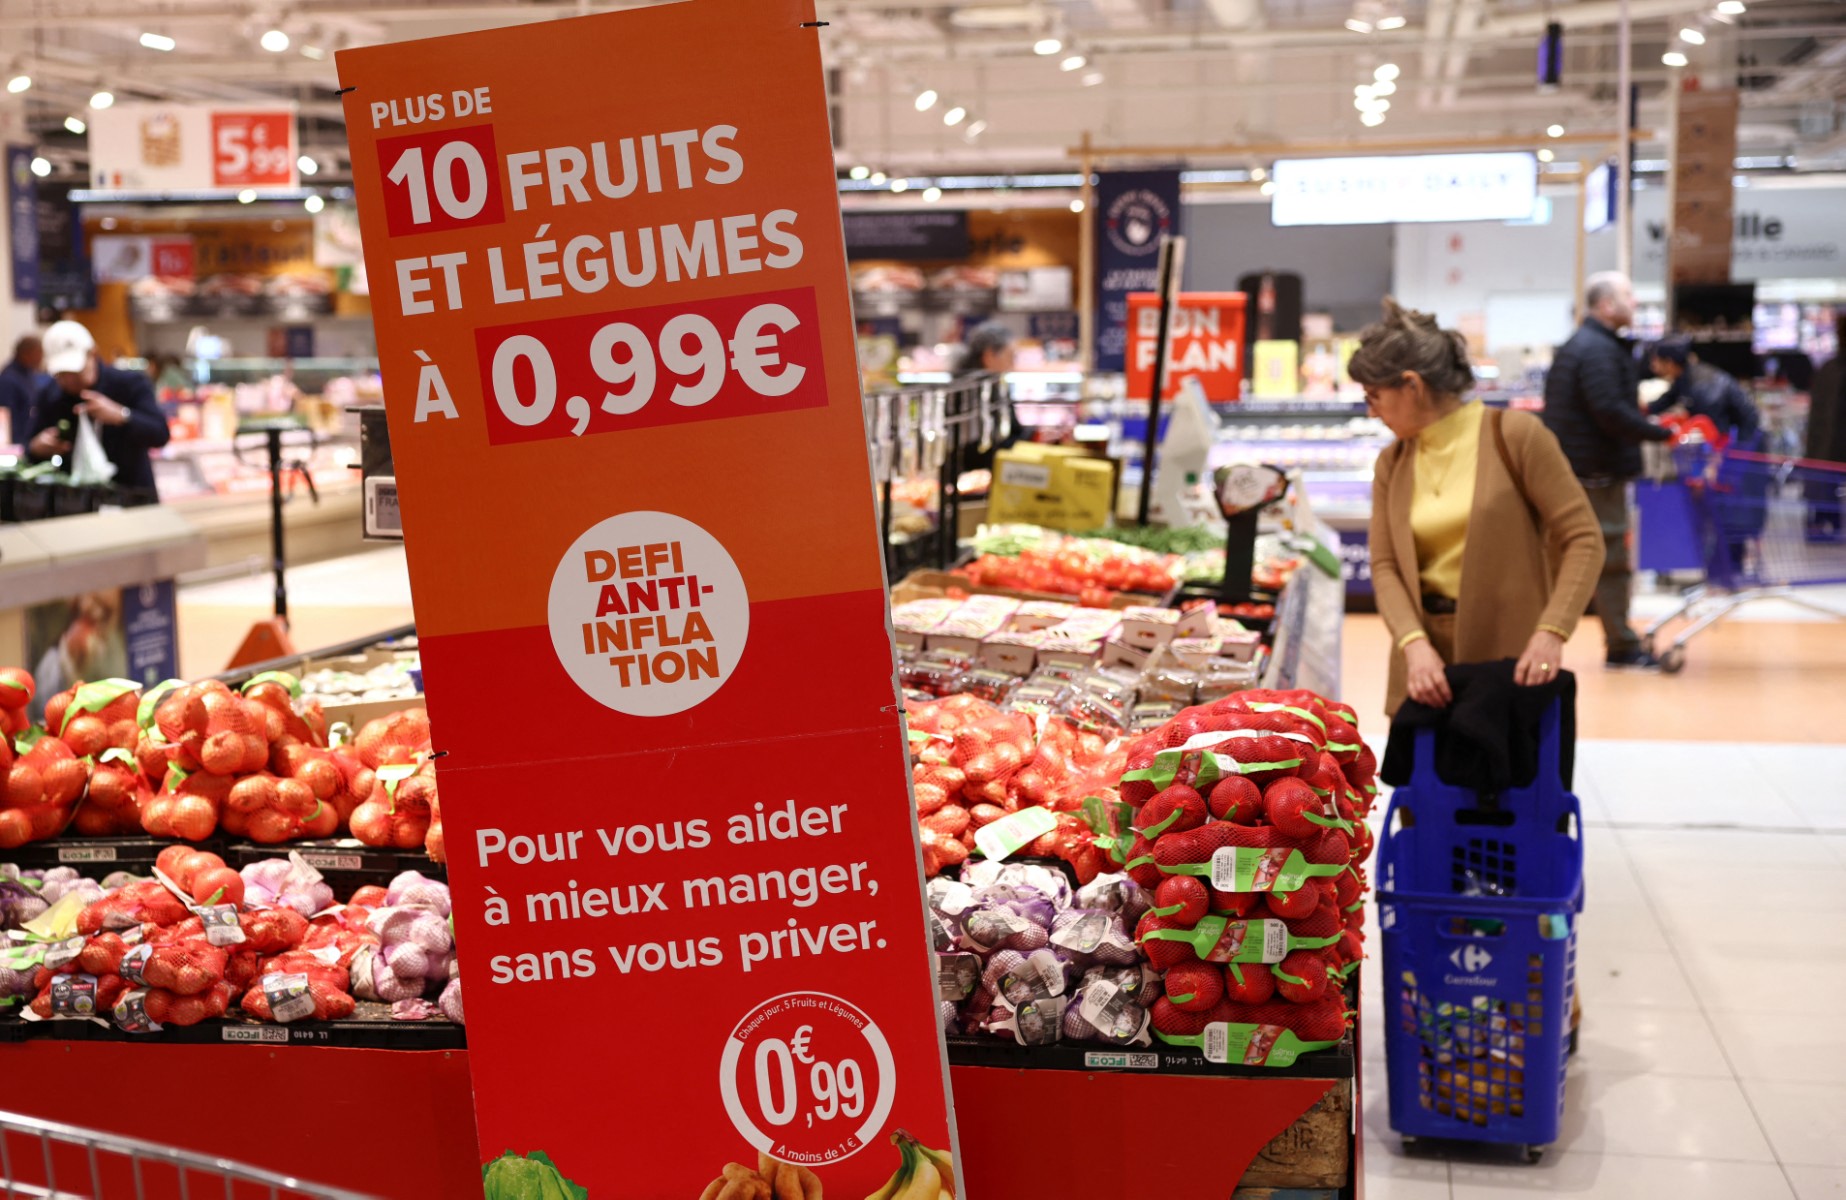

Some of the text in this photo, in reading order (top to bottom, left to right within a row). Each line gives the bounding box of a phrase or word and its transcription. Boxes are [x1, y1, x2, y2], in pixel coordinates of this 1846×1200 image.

[371, 87, 492, 128] PLUS DE
[388, 124, 744, 224] 10 FRUITS
[396, 209, 804, 316] ET LÉGUMES
[1137, 306, 1220, 337] BON
[412, 303, 807, 436] À 0,99€
[584, 542, 684, 583] DEFI
[596, 575, 714, 618] ANTI-
[582, 612, 715, 655] INFLA
[610, 647, 720, 688] TION
[477, 800, 848, 868] Pour vous aider
[485, 861, 879, 925] à mieux manger,
[491, 918, 887, 984] sans vous priver.
[1444, 974, 1498, 987] Carrefour
[738, 997, 864, 1040] Chaque jour, 5 Fruits et Légumes
[1100, 1057, 1127, 1066] IFCO
[777, 1137, 857, 1162] A moins de 1 €
